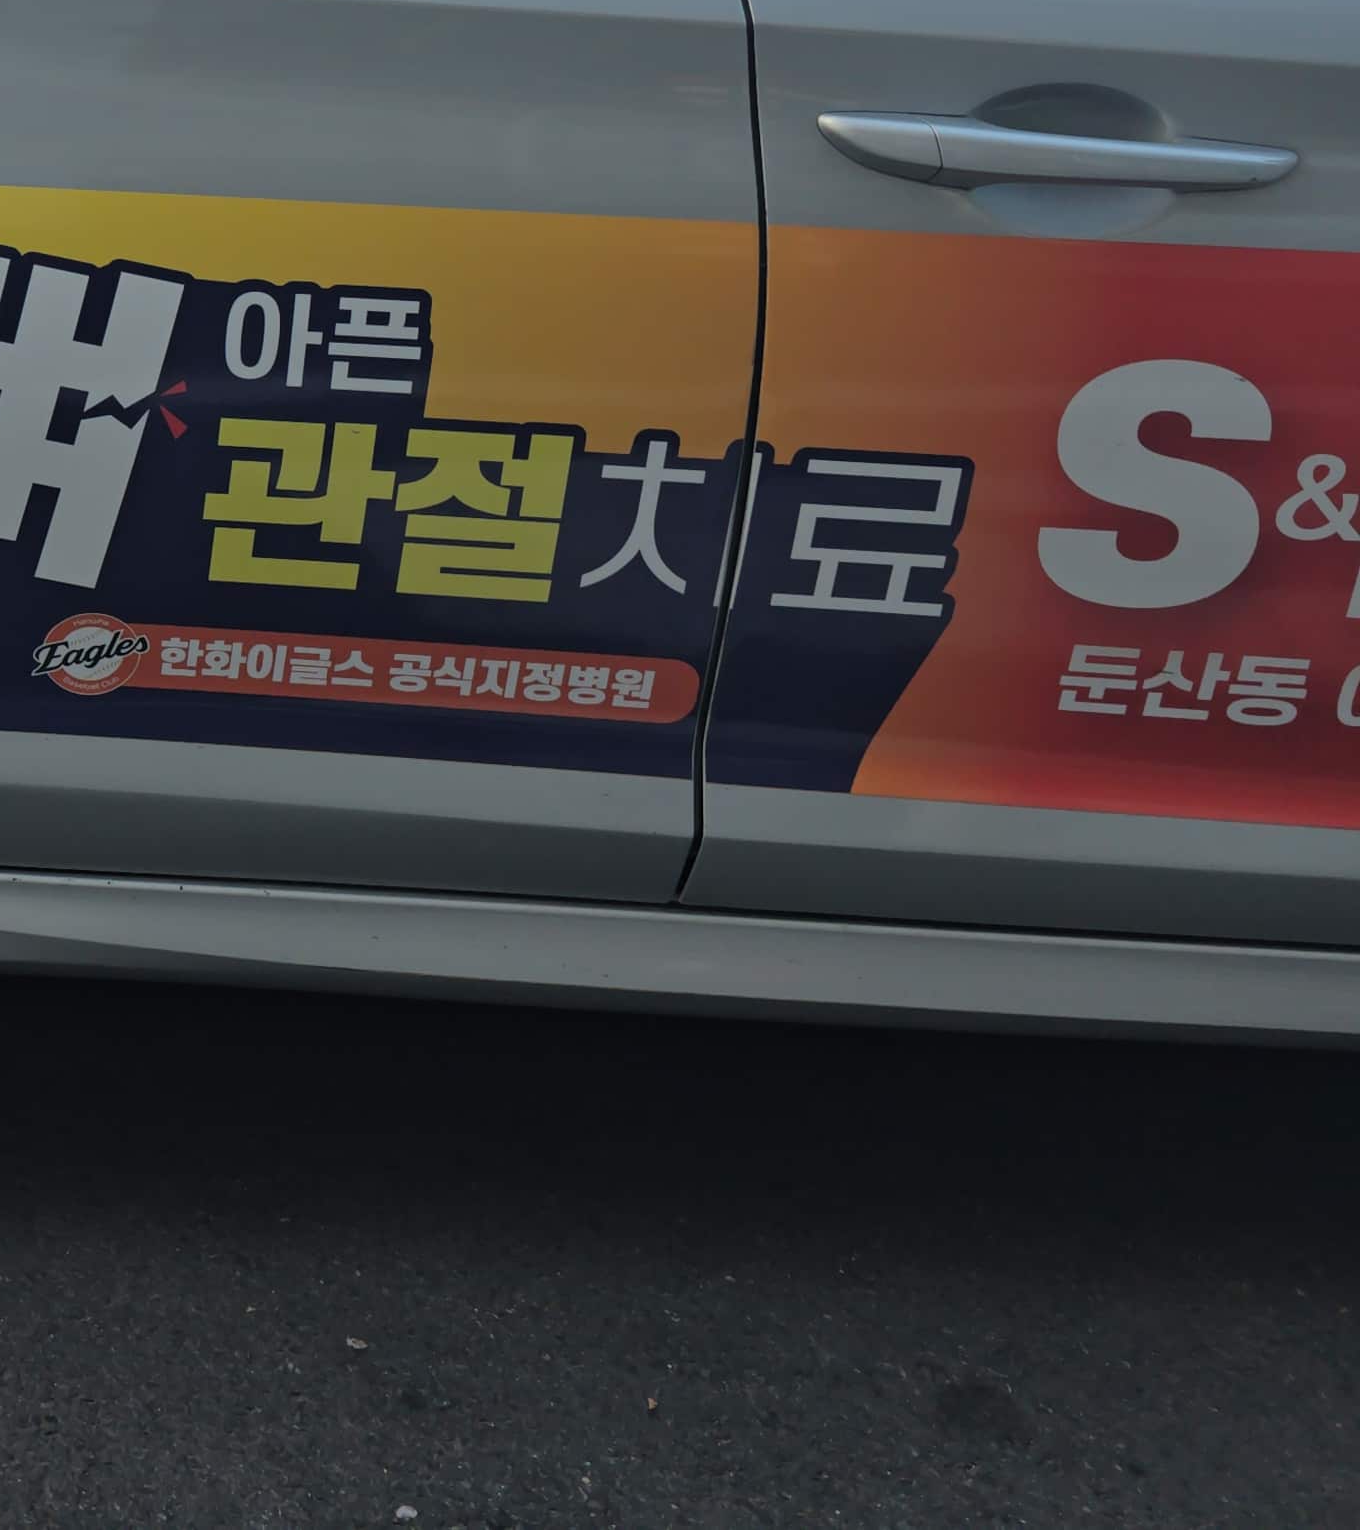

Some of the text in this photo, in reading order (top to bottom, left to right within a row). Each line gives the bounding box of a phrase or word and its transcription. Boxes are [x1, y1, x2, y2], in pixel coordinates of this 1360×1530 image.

[223, 286, 422, 397] 아픈
[32, 630, 150, 676] Eagles
[159, 635, 655, 712] 한화이글스 공식지정병원
[1057, 643, 1312, 728] 둔산동
